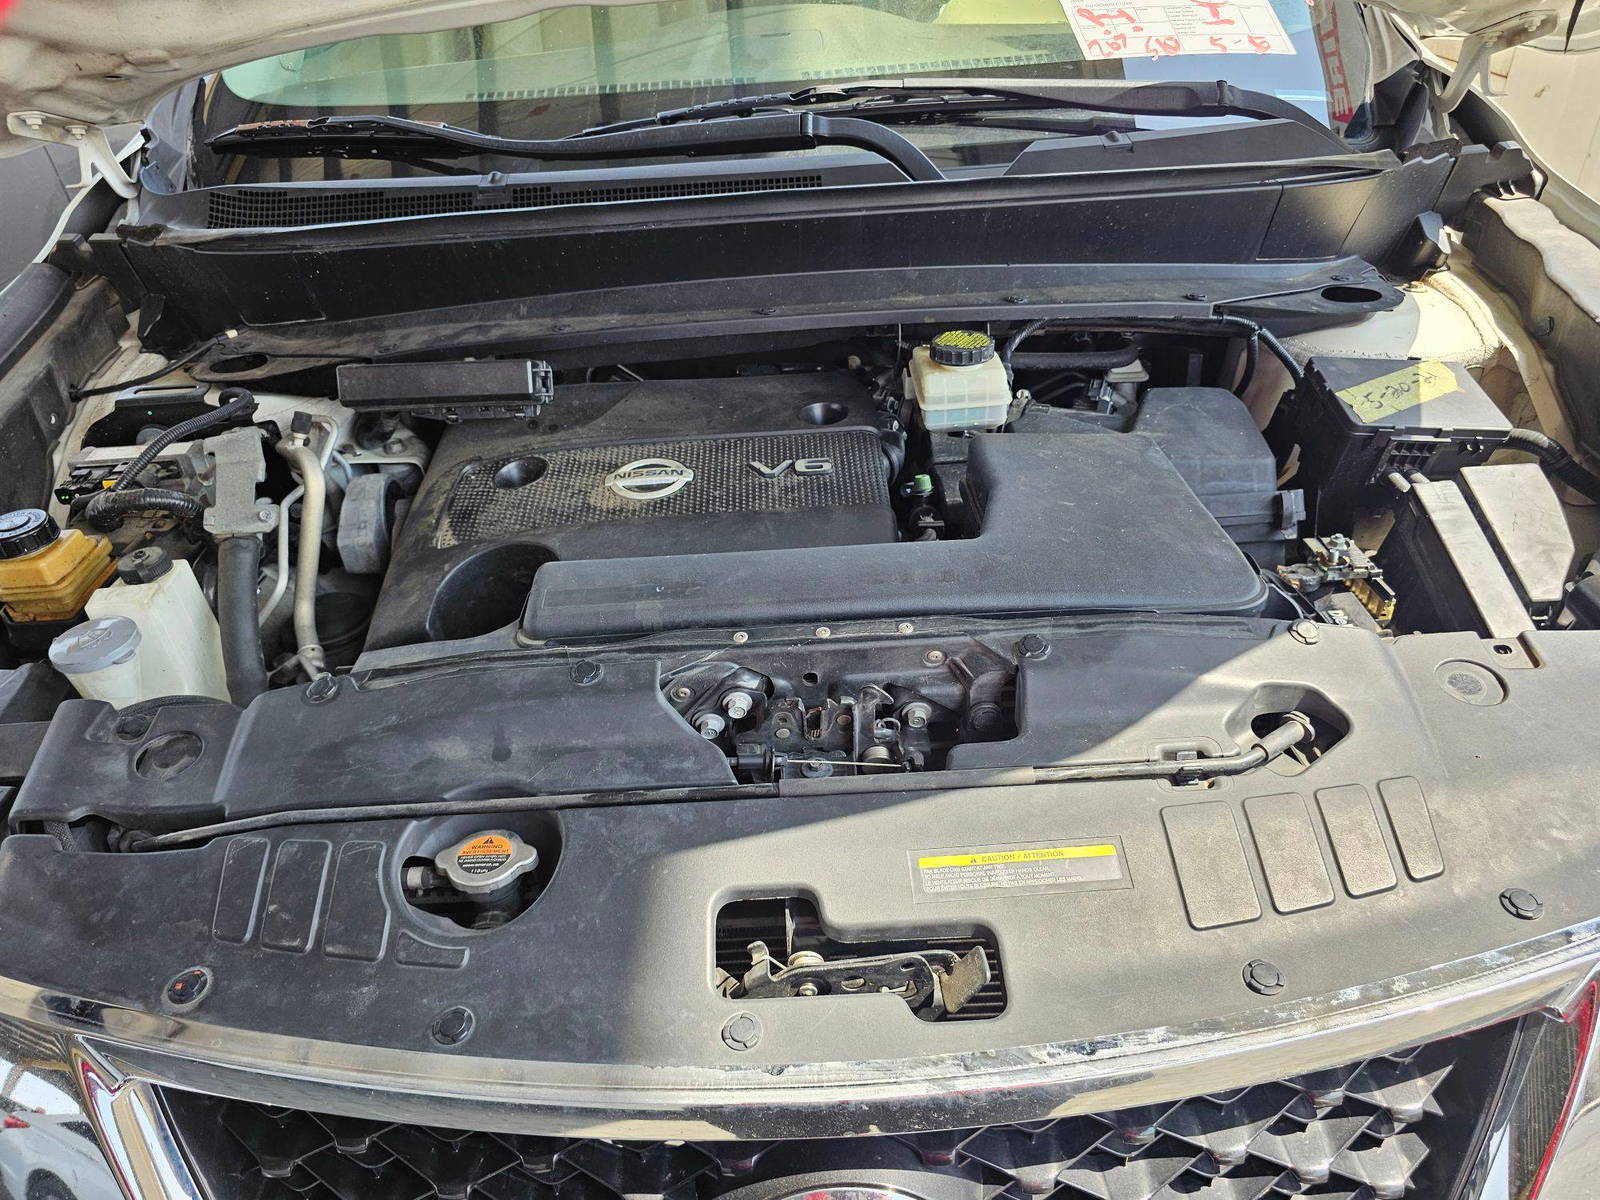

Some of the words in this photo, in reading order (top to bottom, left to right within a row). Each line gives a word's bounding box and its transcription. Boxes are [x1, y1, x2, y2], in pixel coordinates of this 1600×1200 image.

[614, 468, 684, 480] NISSAN
[748, 457, 834, 479] V6
[981, 852, 1016, 863] CAUTION
[1023, 850, 1064, 861] ATTENTION
